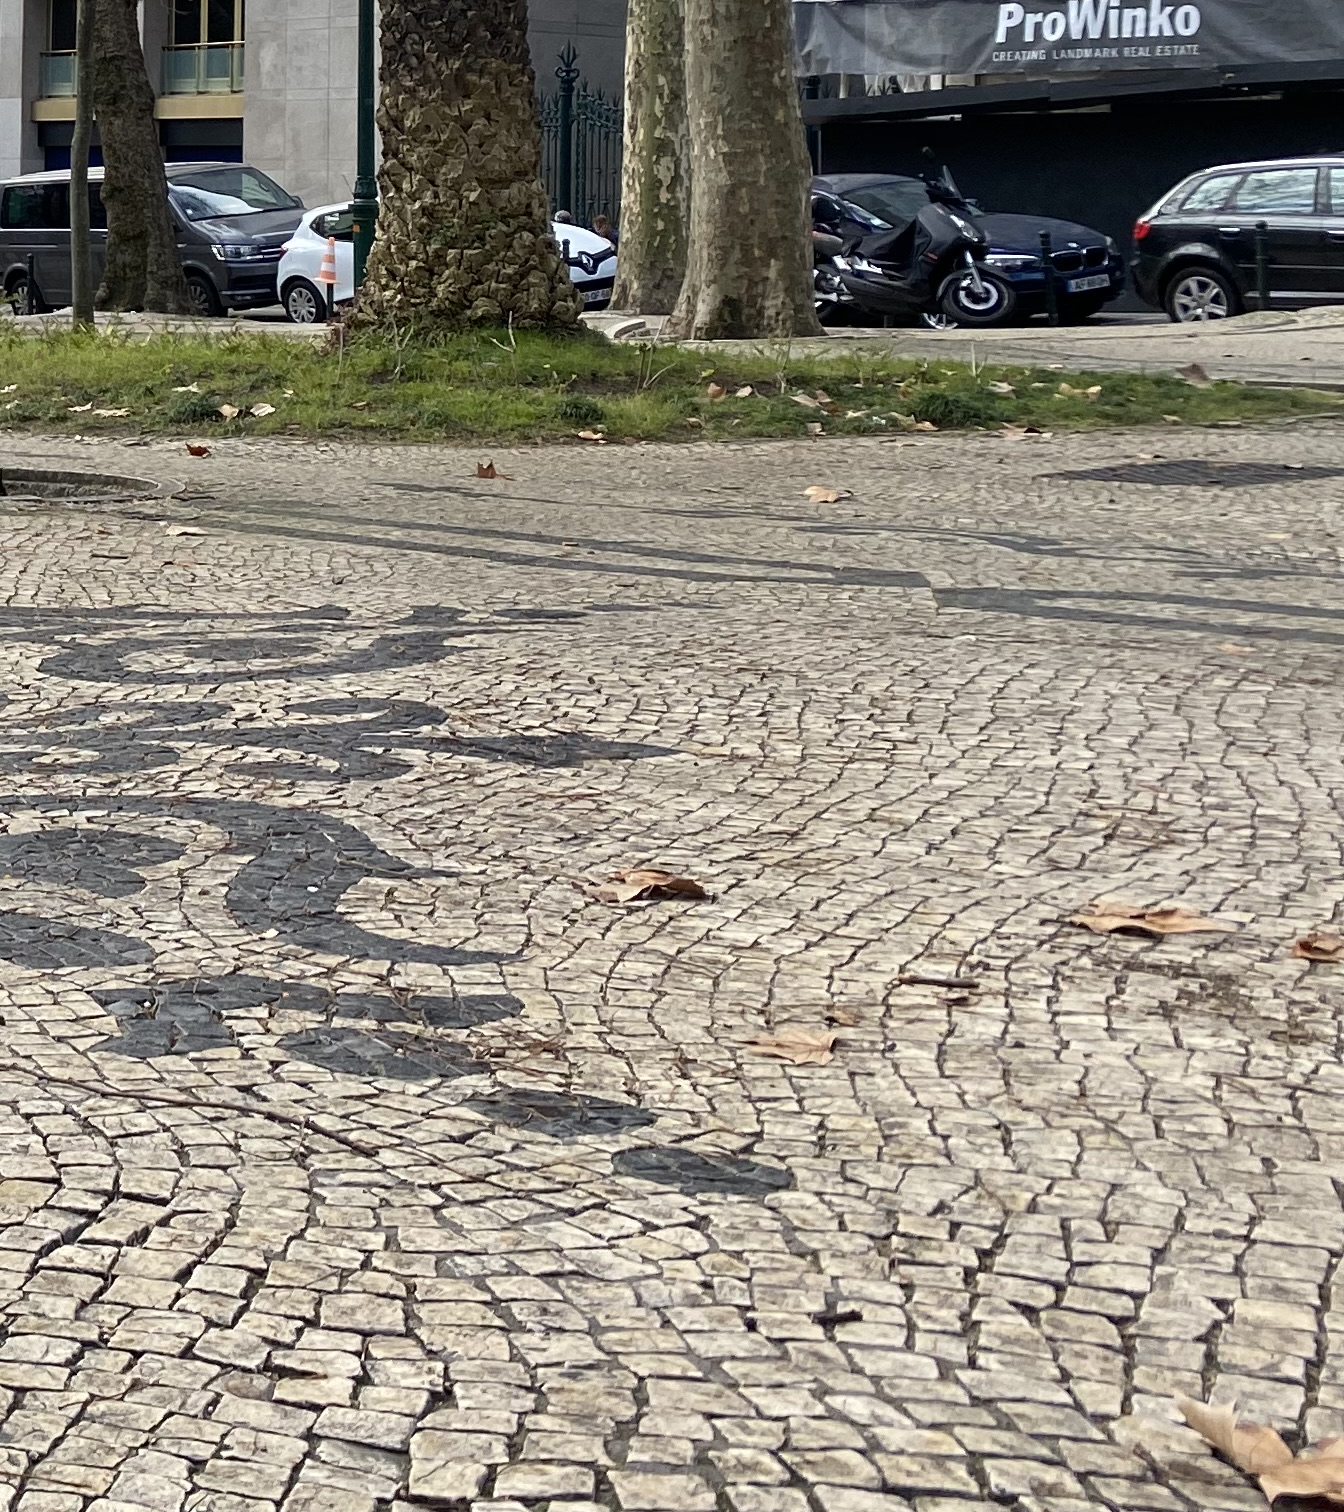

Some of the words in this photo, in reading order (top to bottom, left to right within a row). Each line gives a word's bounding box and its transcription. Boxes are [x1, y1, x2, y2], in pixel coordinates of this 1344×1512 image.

[992, 49, 1047, 62] CREATING
[1052, 47, 1119, 60] LANDMARK
[1123, 46, 1152, 58] REAL
[1155, 44, 1200, 57] ESTATE
